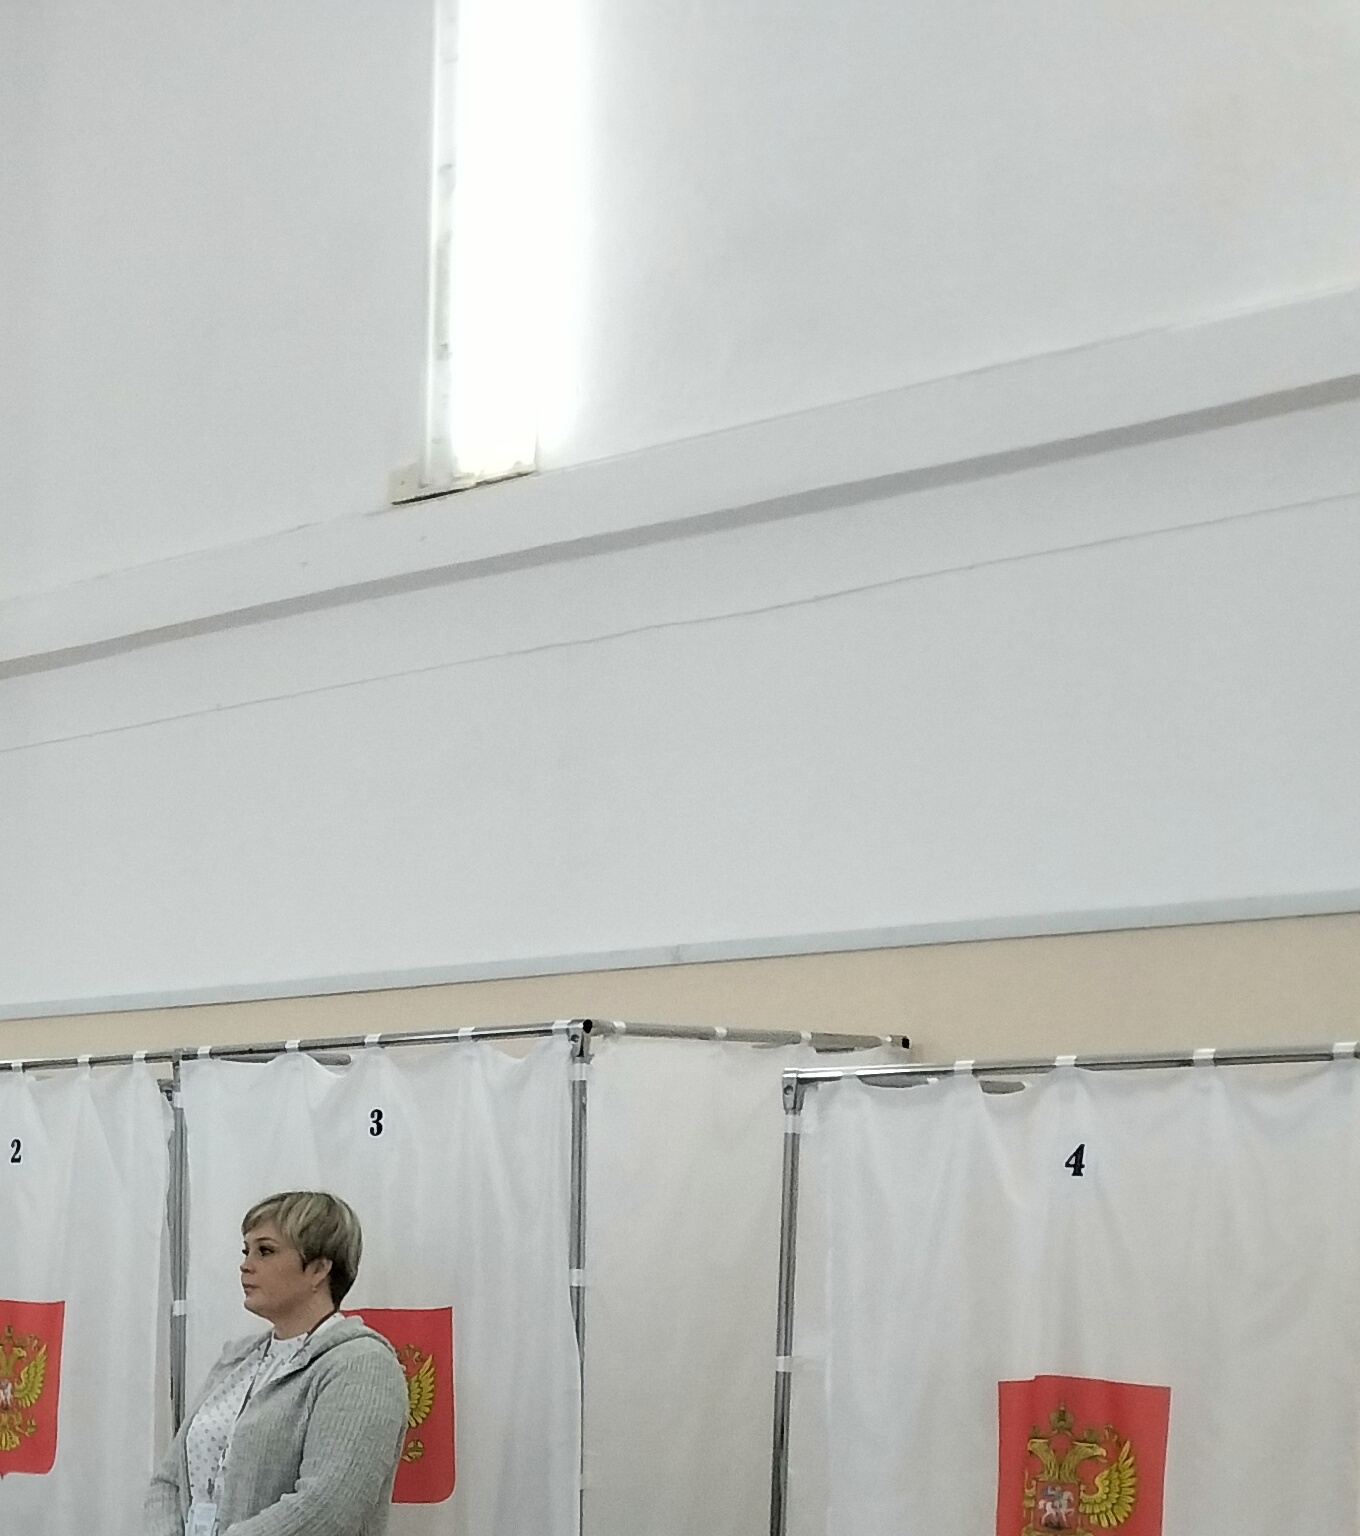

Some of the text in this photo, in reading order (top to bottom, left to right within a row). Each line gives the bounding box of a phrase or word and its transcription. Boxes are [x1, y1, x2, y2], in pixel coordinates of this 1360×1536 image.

[370, 1109, 383, 1136] 3
[11, 1139, 21, 1163] 2
[1064, 1143, 1085, 1176] 4
